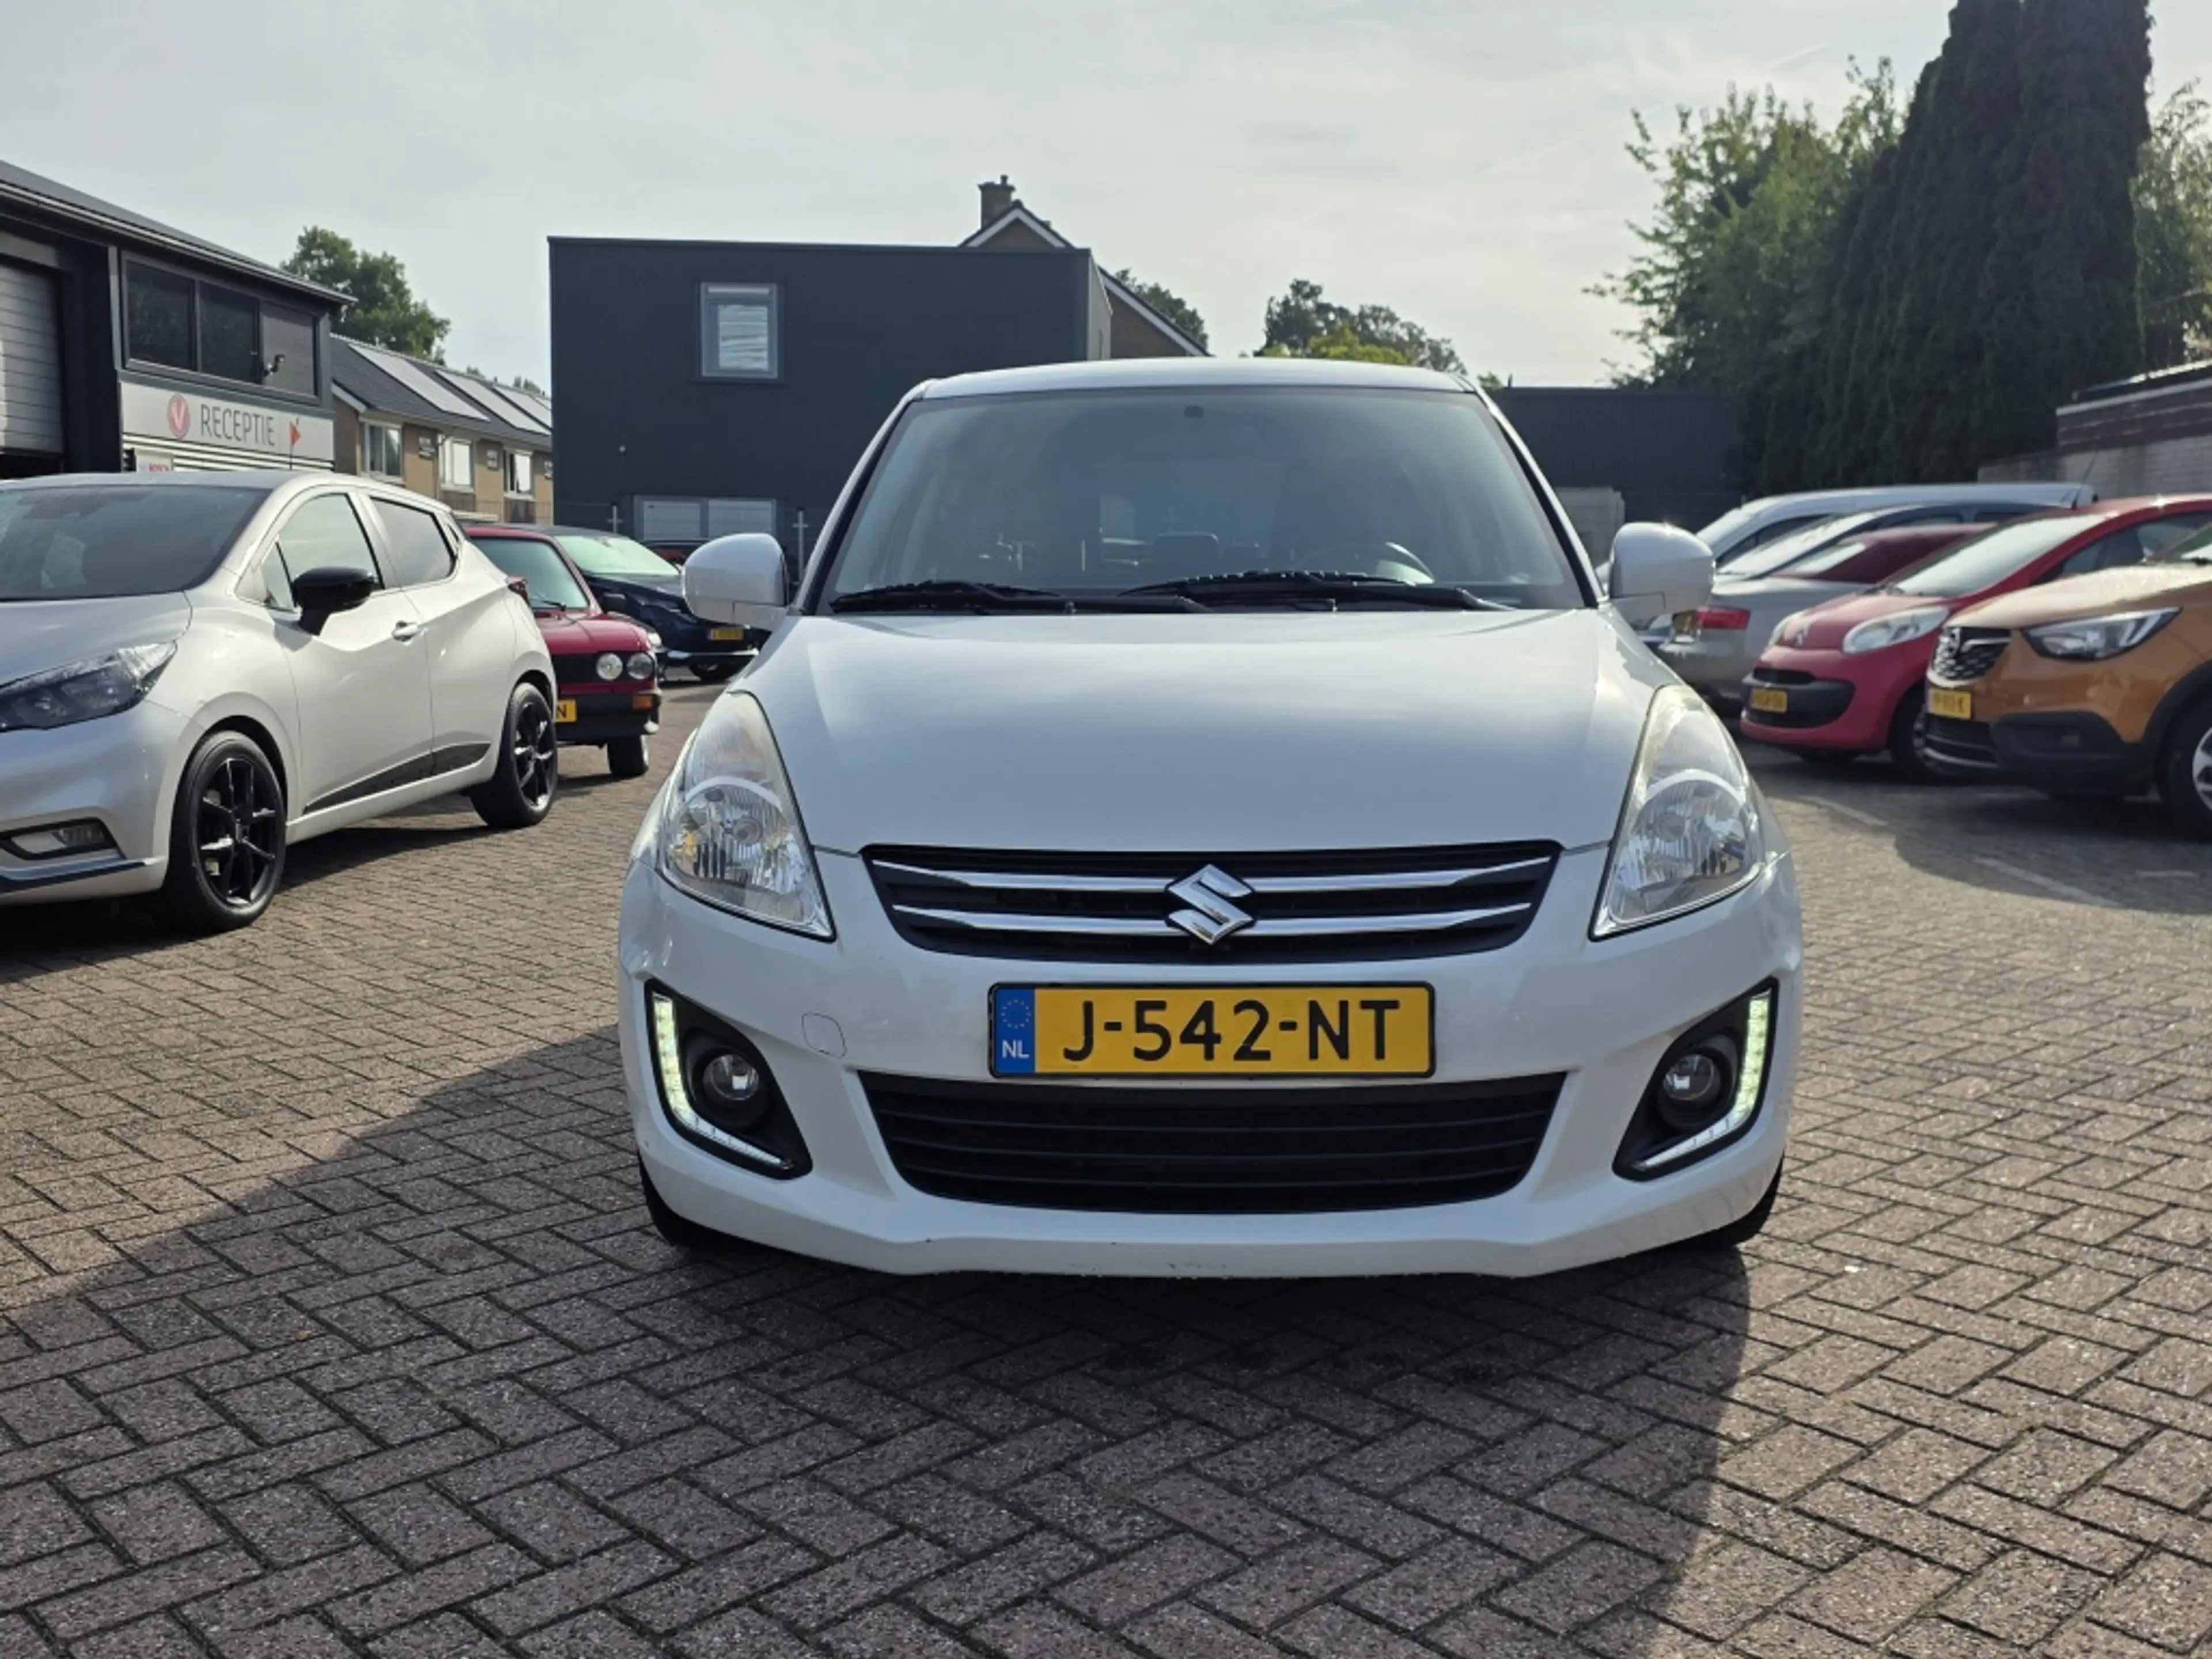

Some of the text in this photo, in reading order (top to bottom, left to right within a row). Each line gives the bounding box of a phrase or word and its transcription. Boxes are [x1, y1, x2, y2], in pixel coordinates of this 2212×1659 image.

[200, 403, 275, 446] RECEPTIE
[1002, 1040, 1029, 1059] NL
[1063, 999, 1400, 1061] J-542-NT
